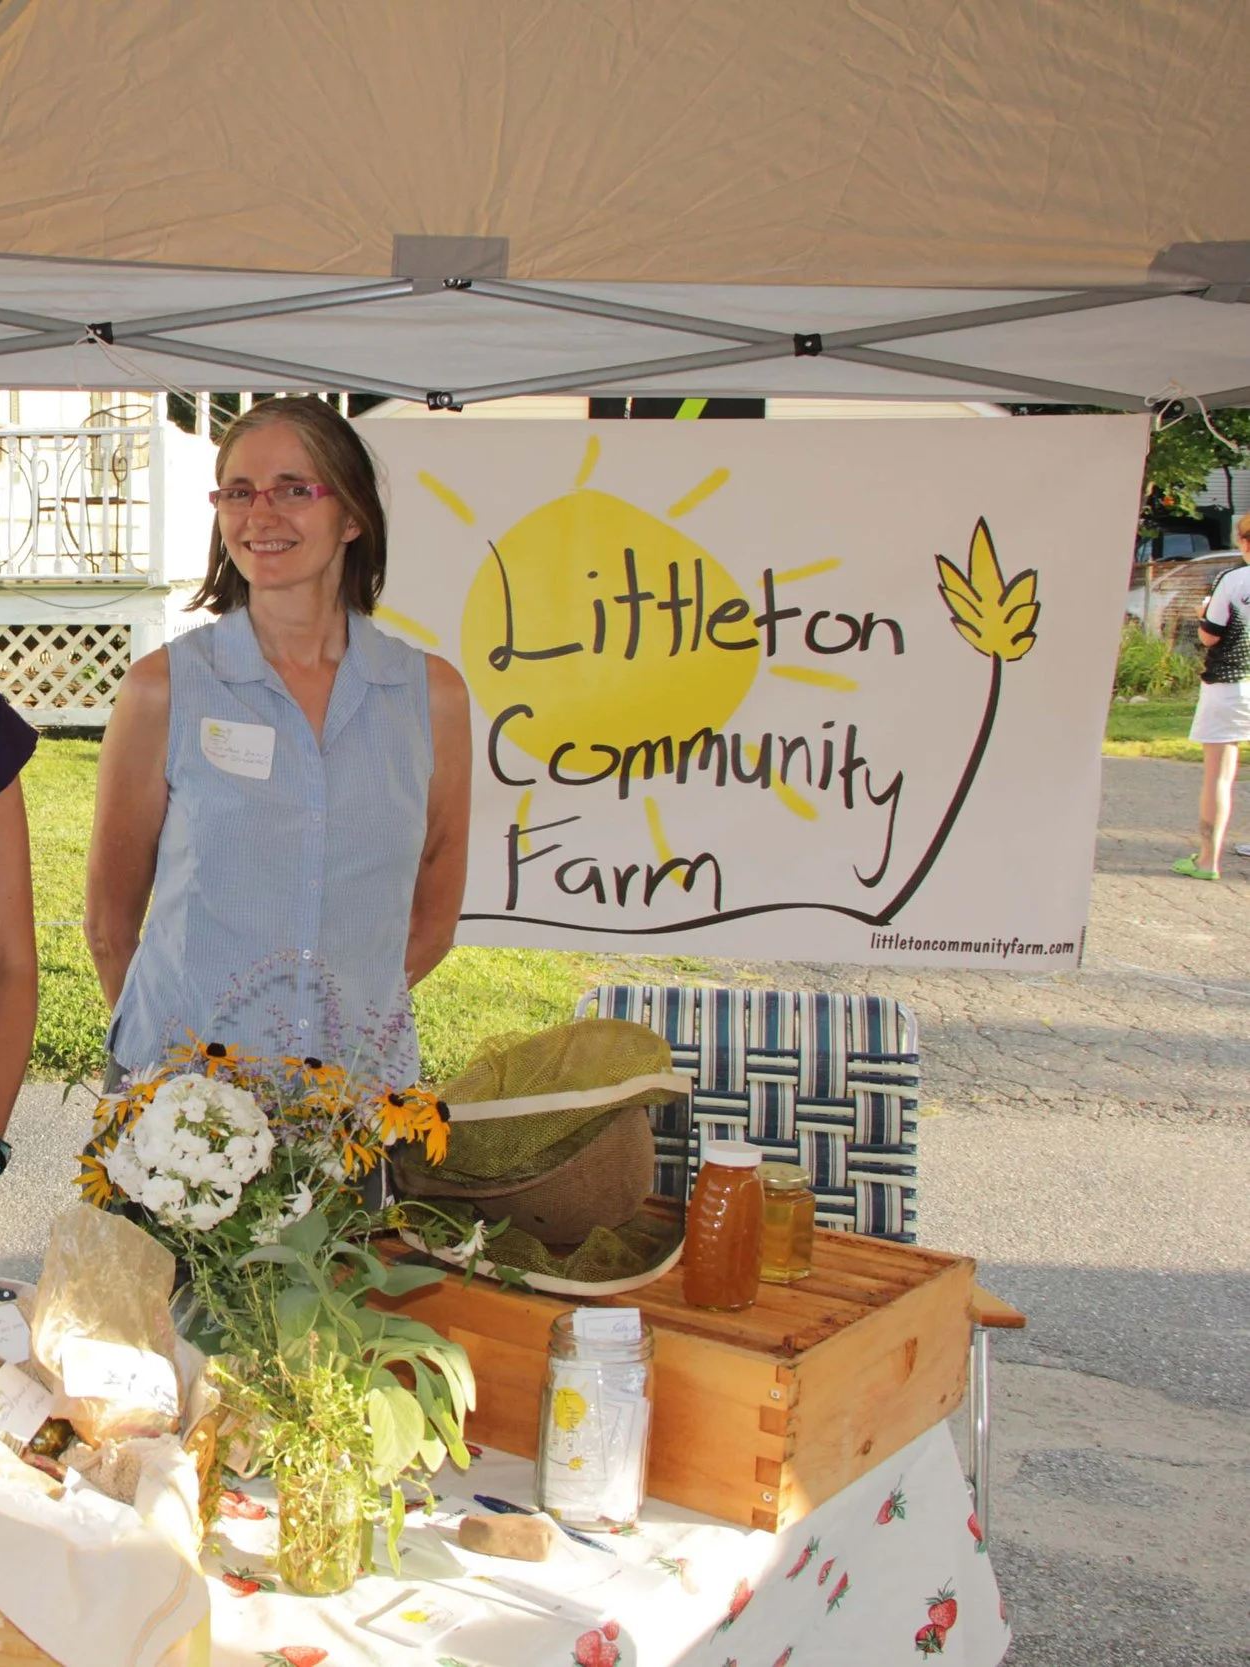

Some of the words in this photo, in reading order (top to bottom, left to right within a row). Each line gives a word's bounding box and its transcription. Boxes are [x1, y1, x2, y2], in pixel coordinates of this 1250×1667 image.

[488, 539, 904, 671] Littleton
[488, 703, 903, 888] Community
[505, 815, 723, 911] Farm
[870, 932, 1074, 958] littletoncommunityfarm.com
